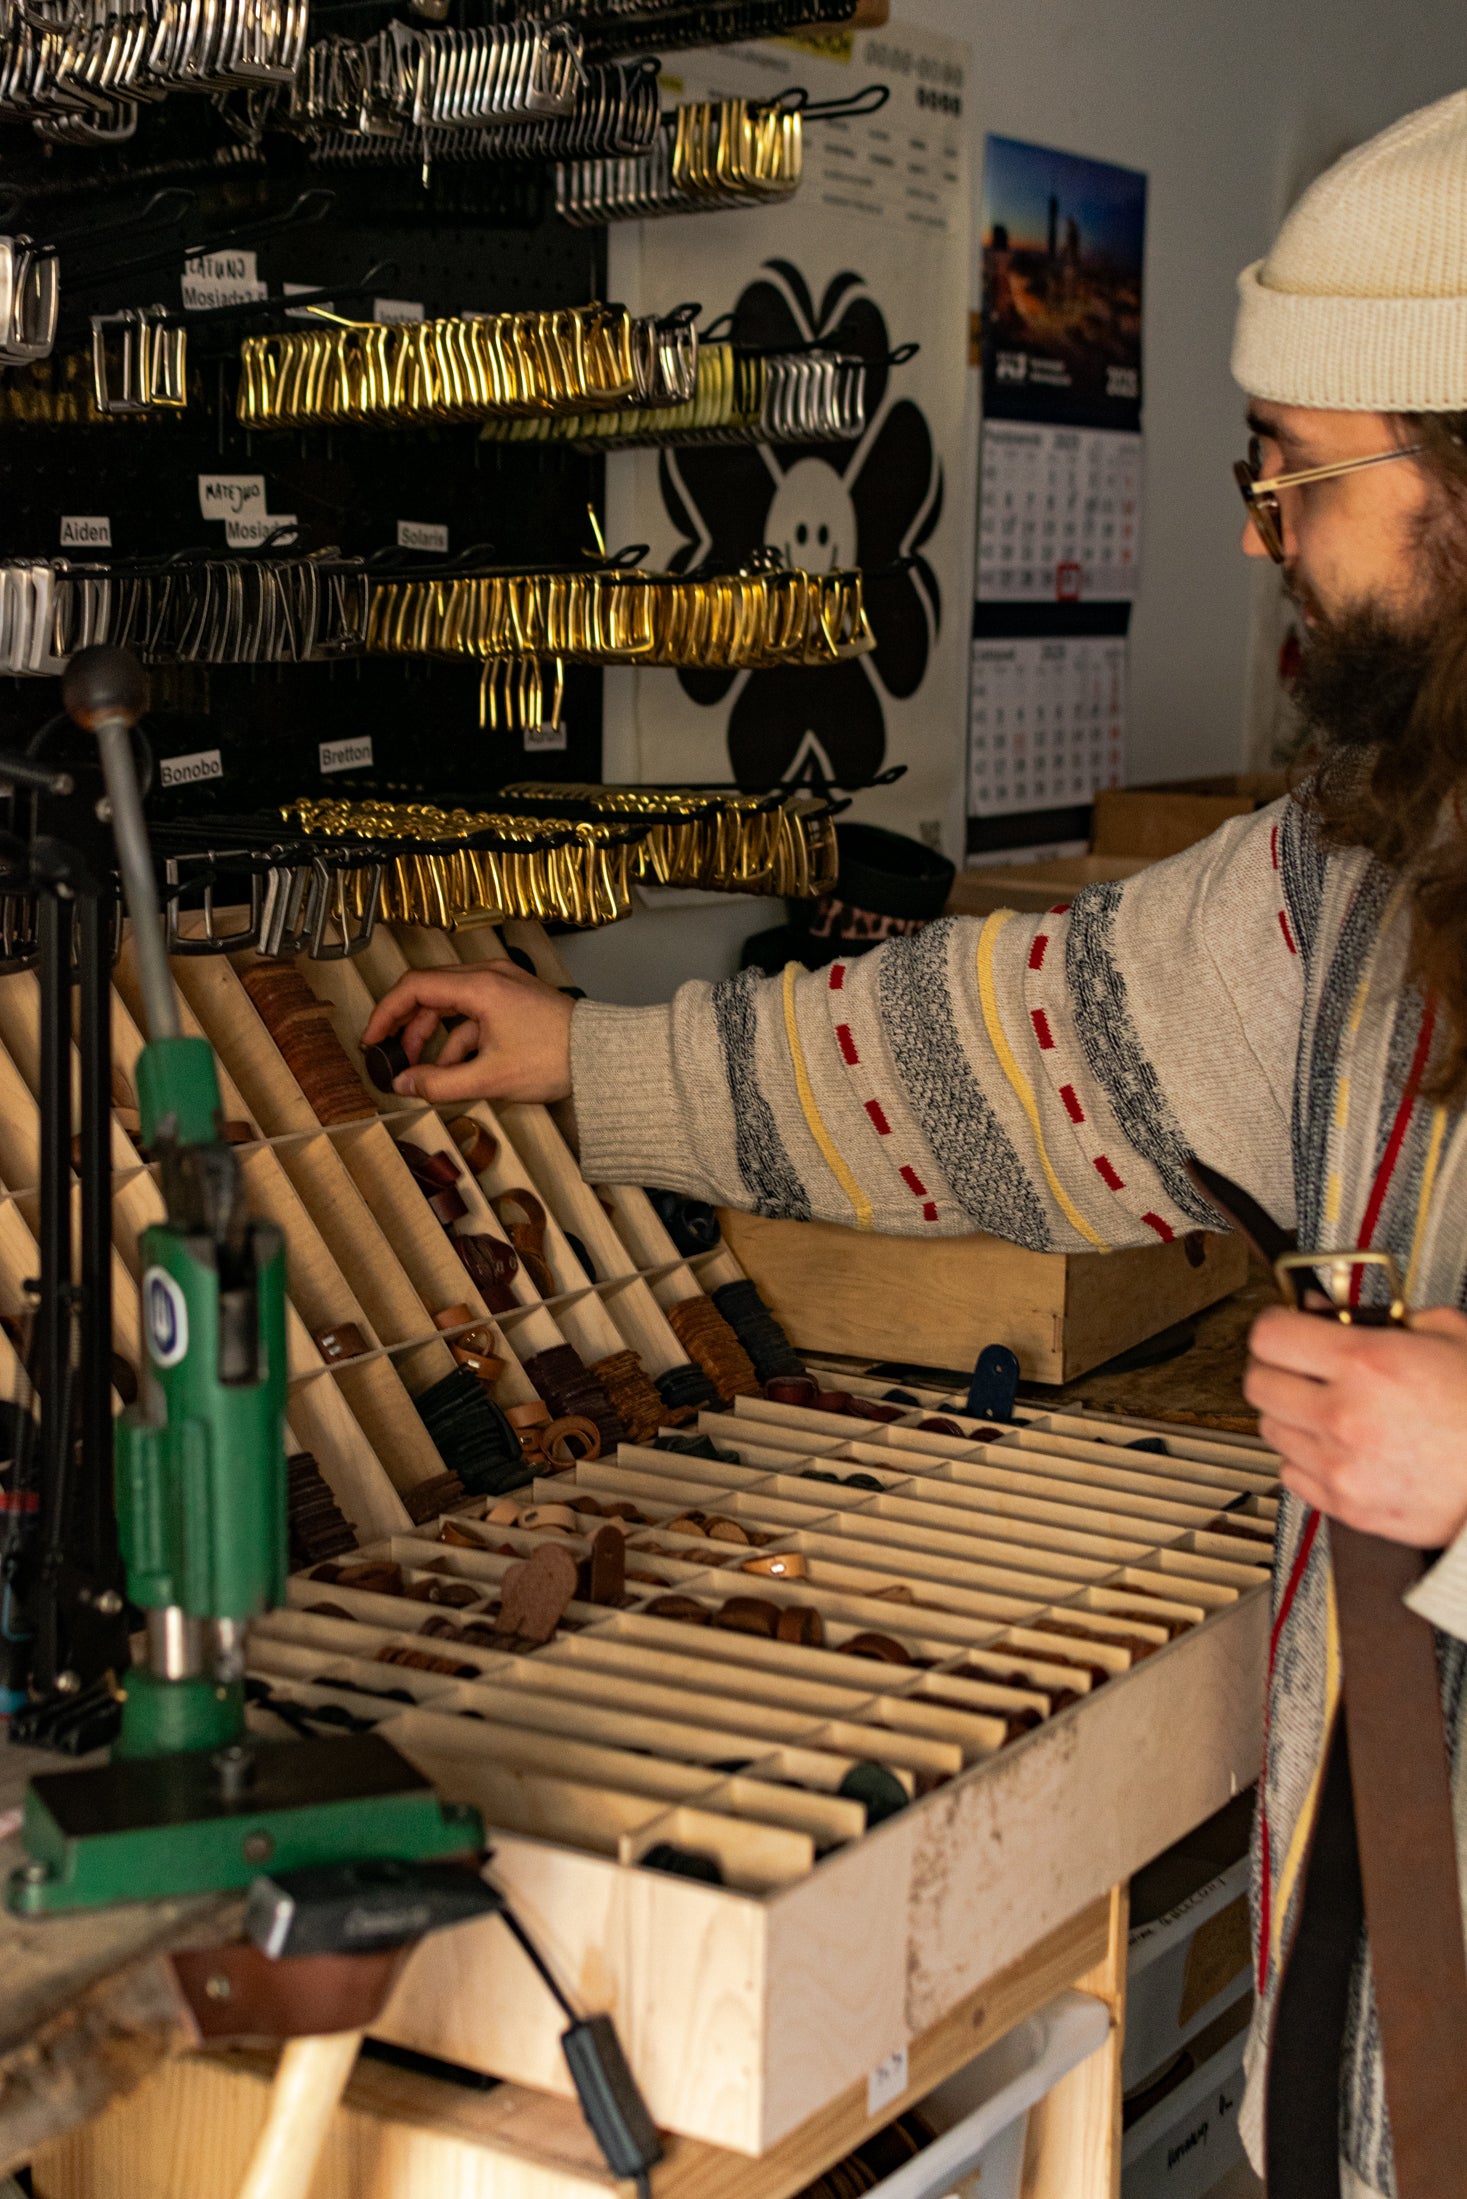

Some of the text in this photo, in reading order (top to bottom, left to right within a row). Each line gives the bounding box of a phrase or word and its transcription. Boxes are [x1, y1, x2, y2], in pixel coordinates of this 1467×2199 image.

[63, 522, 108, 541] Aiden
[322, 746, 370, 766] Bretton
[161, 759, 220, 783] Bonobo
